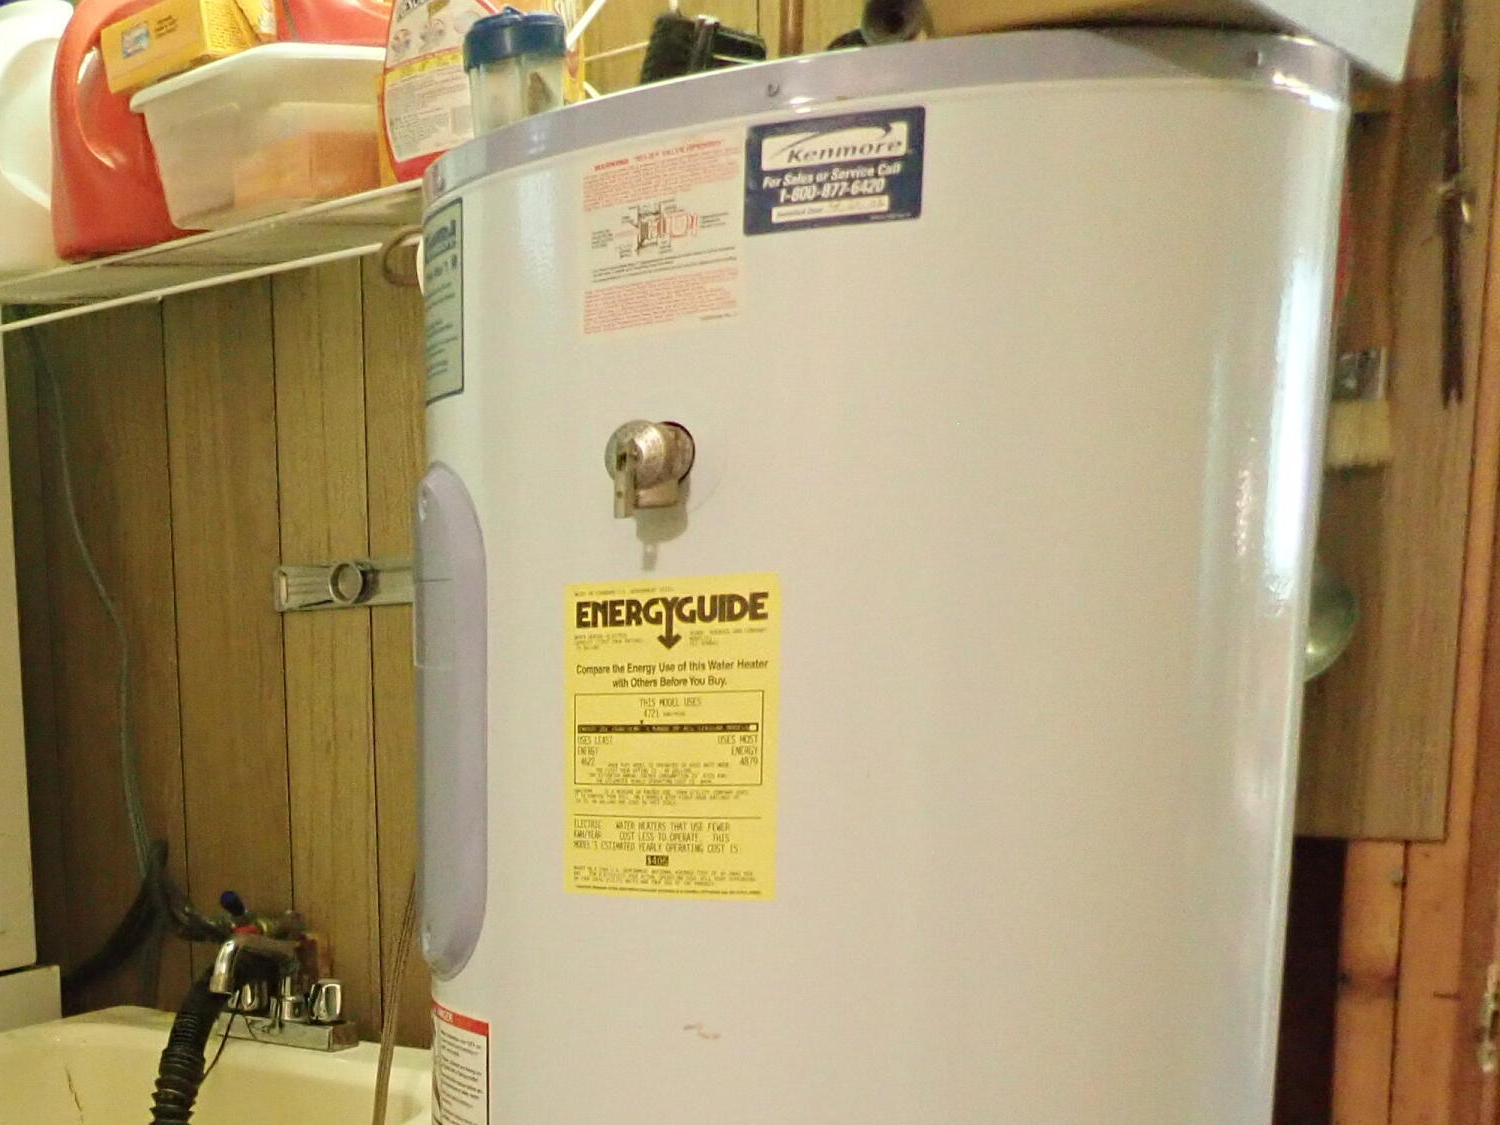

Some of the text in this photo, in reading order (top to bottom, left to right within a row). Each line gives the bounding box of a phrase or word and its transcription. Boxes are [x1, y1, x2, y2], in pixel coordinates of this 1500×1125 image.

[787, 140, 903, 164] Kenmore
[762, 161, 902, 190] For Sales or Service Call
[575, 592, 769, 630] ENERGYGUIDE
[576, 659, 769, 677] Compare the Energy Use of this Water Heater
[612, 675, 728, 688] with Others Before You Buy.
